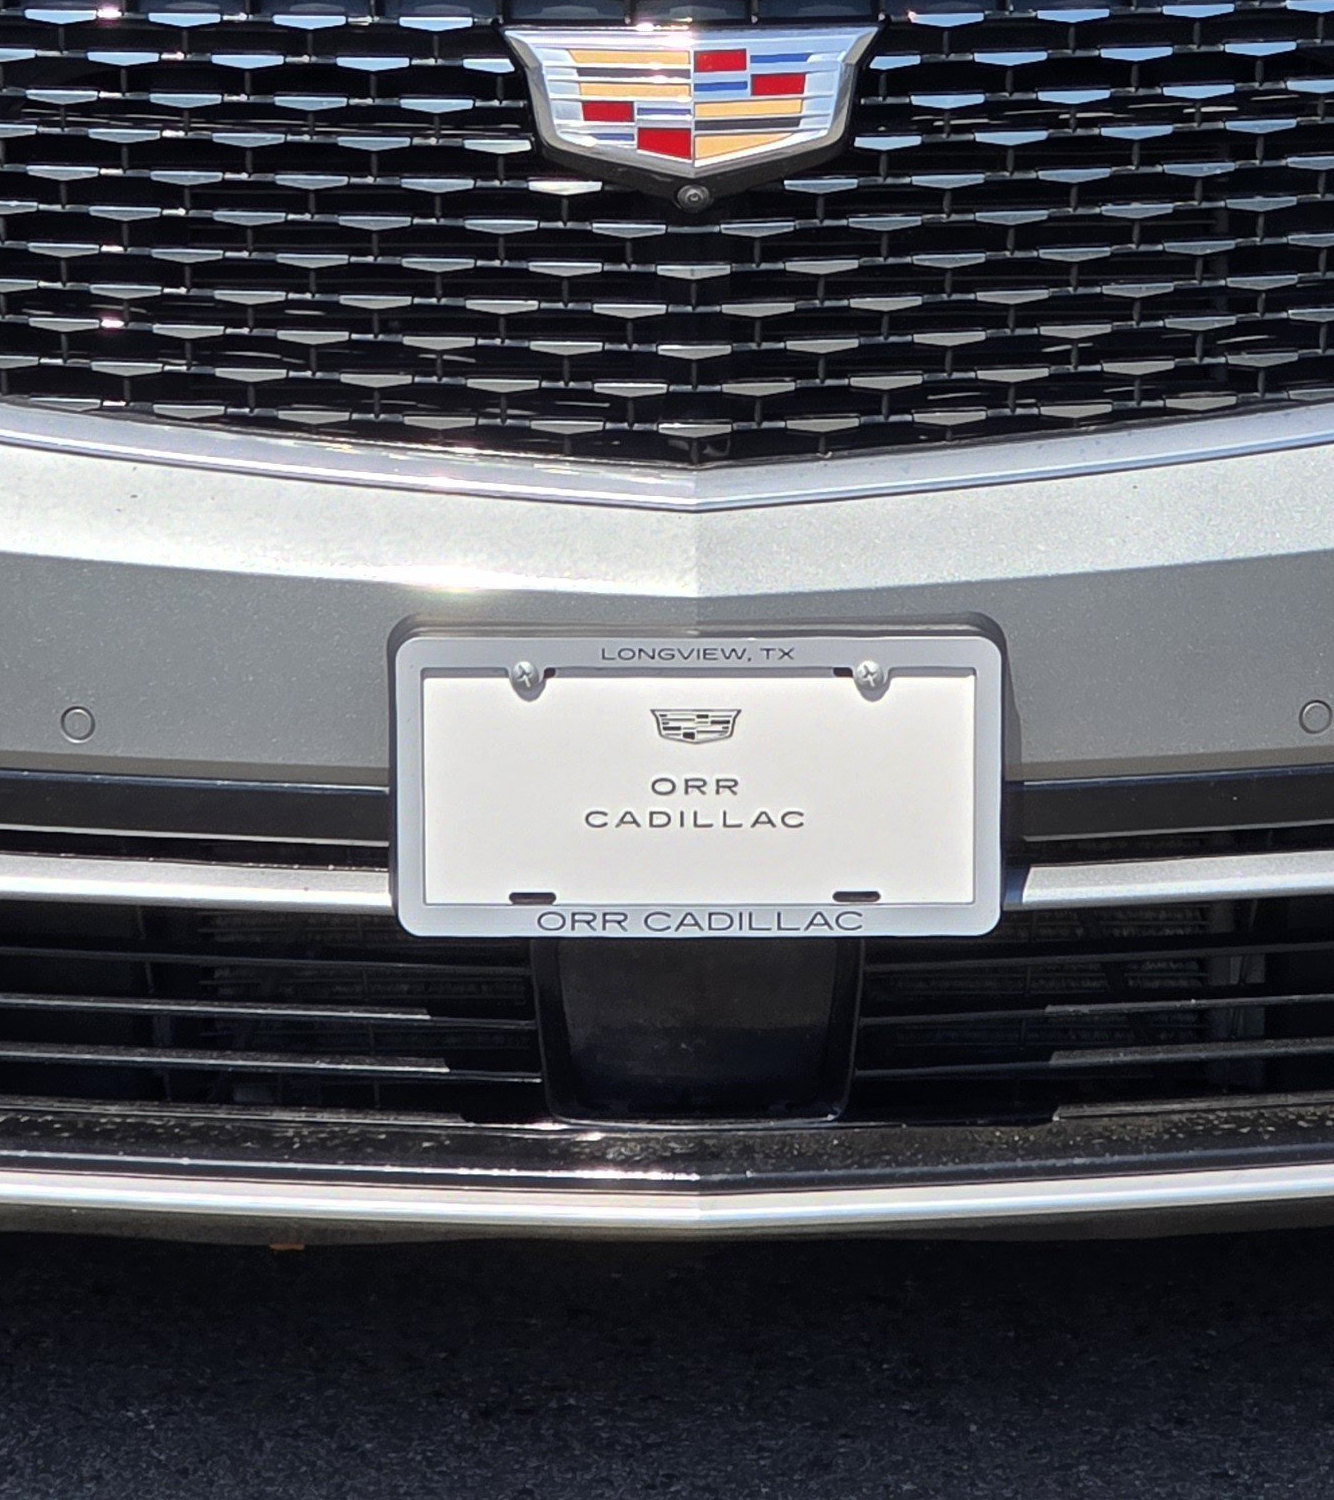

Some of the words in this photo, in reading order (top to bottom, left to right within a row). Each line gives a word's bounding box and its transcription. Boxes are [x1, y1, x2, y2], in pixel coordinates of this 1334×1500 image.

[601, 647, 754, 662] LONGVIEW,
[761, 647, 795, 661] TX
[650, 777, 740, 796] ORR
[584, 810, 805, 829] CADILLAC
[536, 911, 629, 932] ORR
[643, 911, 863, 932] CADILLAC
